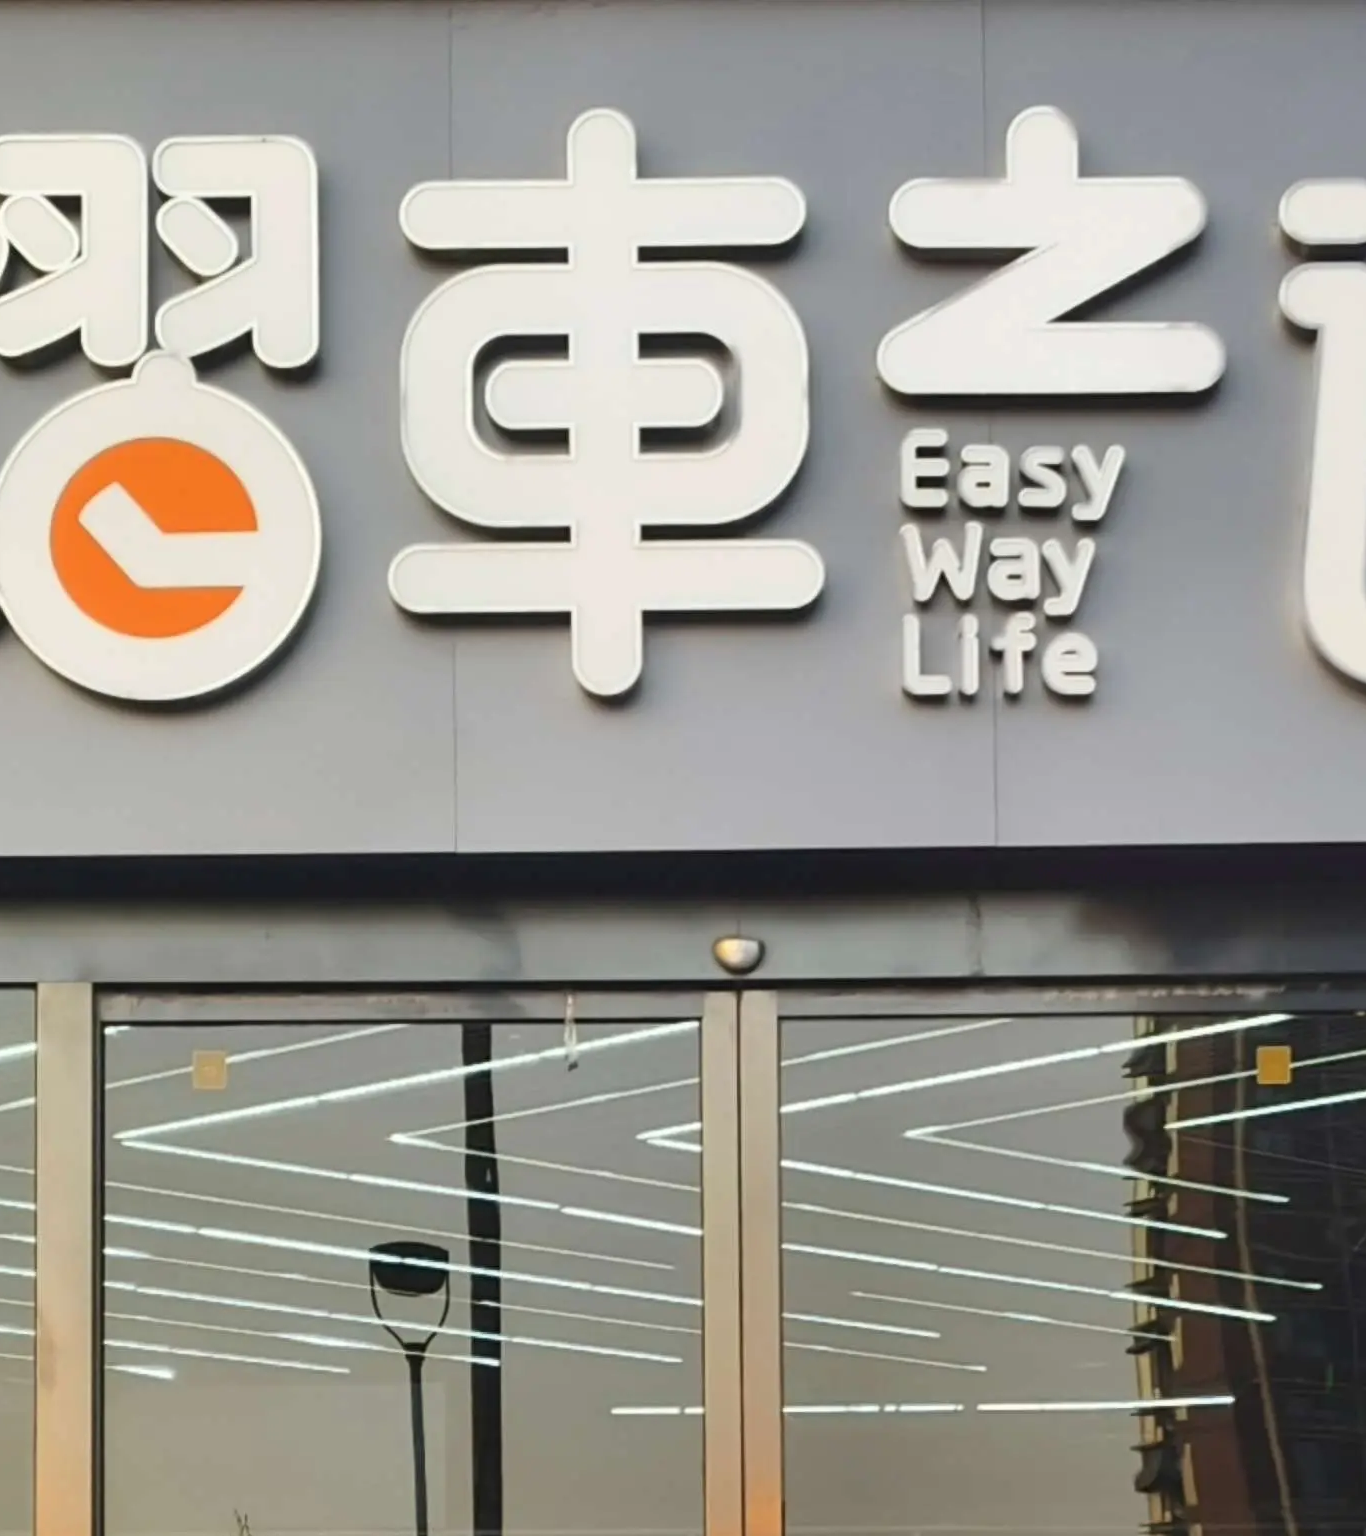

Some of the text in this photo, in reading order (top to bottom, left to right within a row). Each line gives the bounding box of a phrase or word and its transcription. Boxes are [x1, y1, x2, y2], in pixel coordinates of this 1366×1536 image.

[899, 428, 1126, 522] Easy
[899, 521, 1096, 616] Way
[900, 612, 1099, 697] Life
